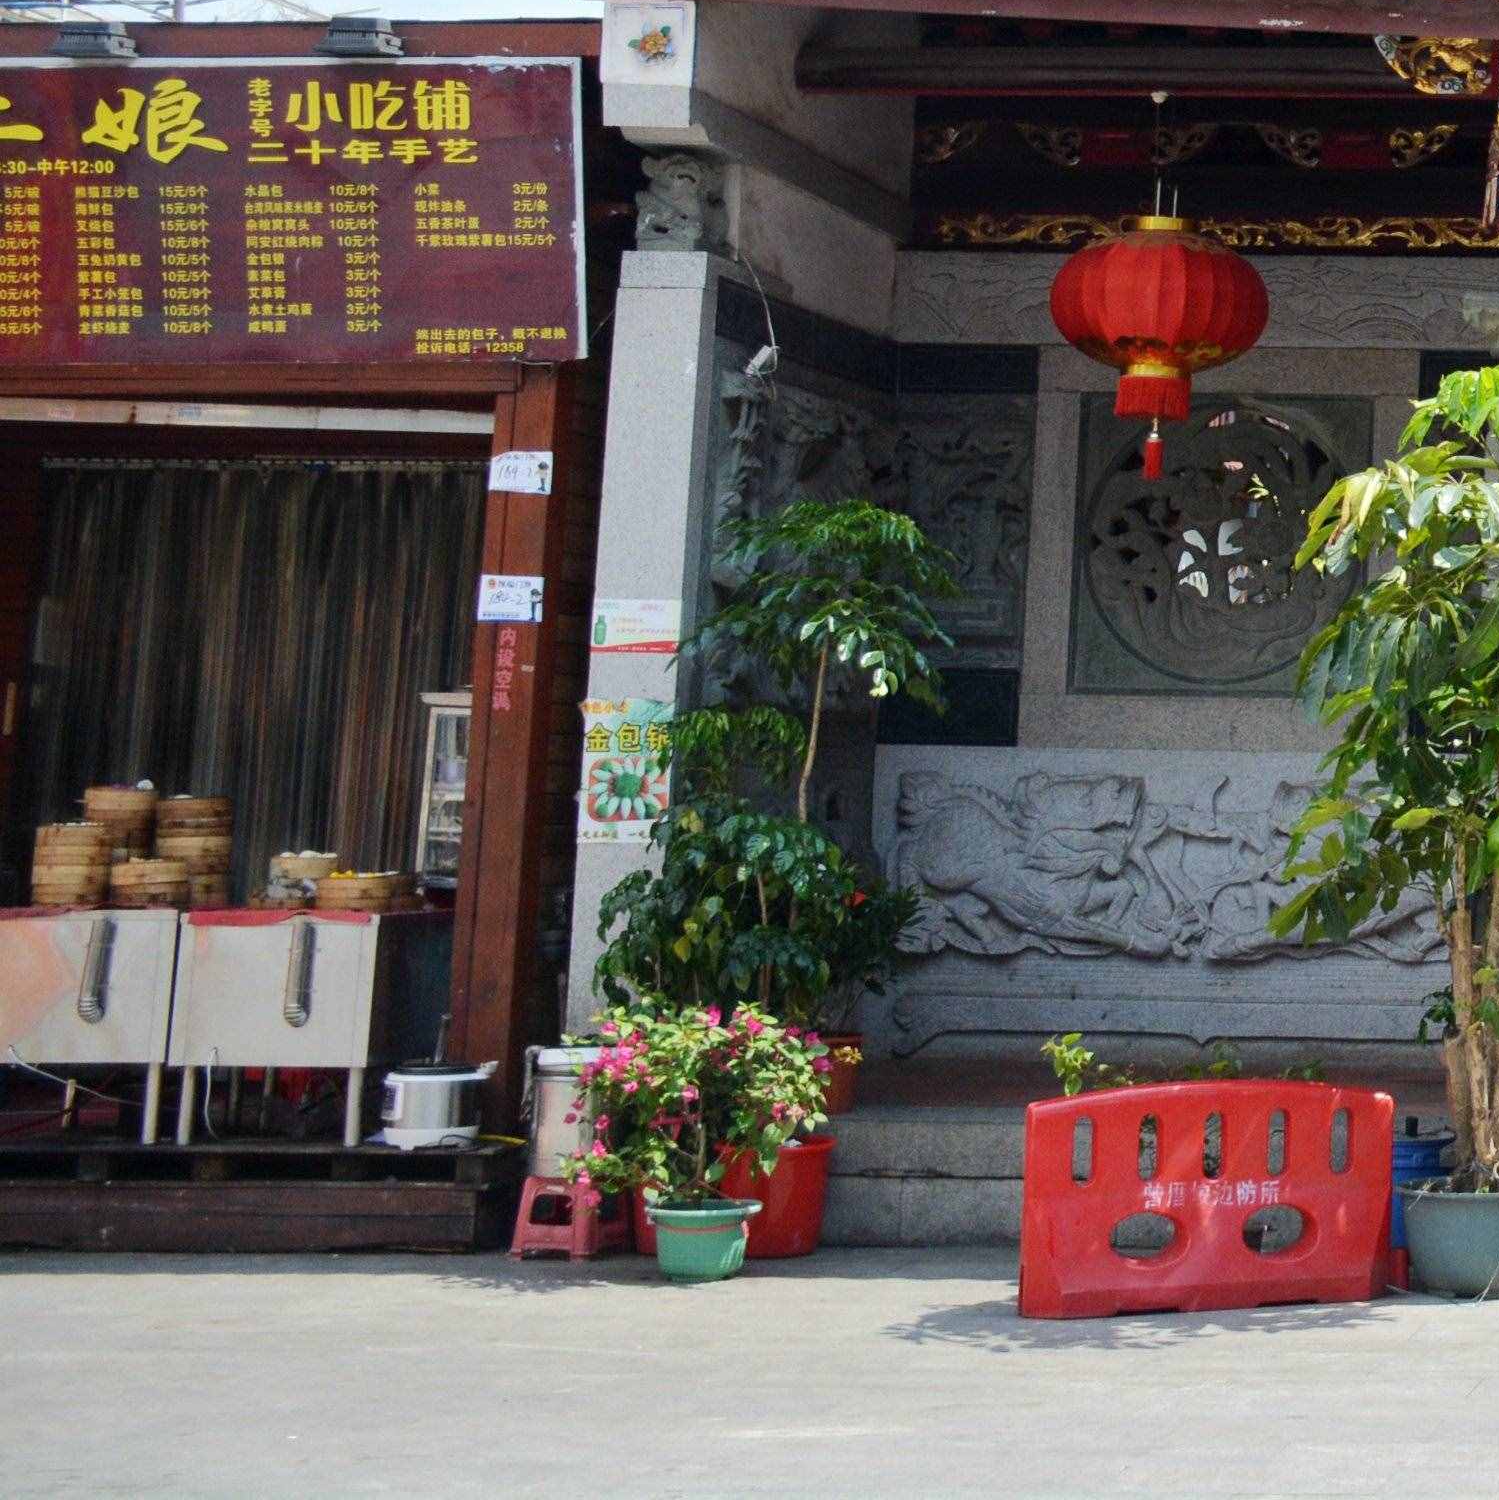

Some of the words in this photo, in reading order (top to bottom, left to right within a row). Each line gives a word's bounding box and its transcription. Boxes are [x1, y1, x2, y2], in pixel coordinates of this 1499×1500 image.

[249, 78, 273, 137] 老字号
[285, 80, 472, 132] 小吃铺
[248, 140, 479, 165] 二十年手艺
[512, 182, 548, 195] 3元/份
[513, 199, 549, 212] 2元/条
[514, 217, 550, 230] 2元/个
[345, 252, 380, 264] 3元/个
[346, 269, 381, 281] 3元/个
[346, 286, 382, 298] 3元/个
[346, 302, 382, 315] 3元/个
[347, 320, 382, 332] 3元/个
